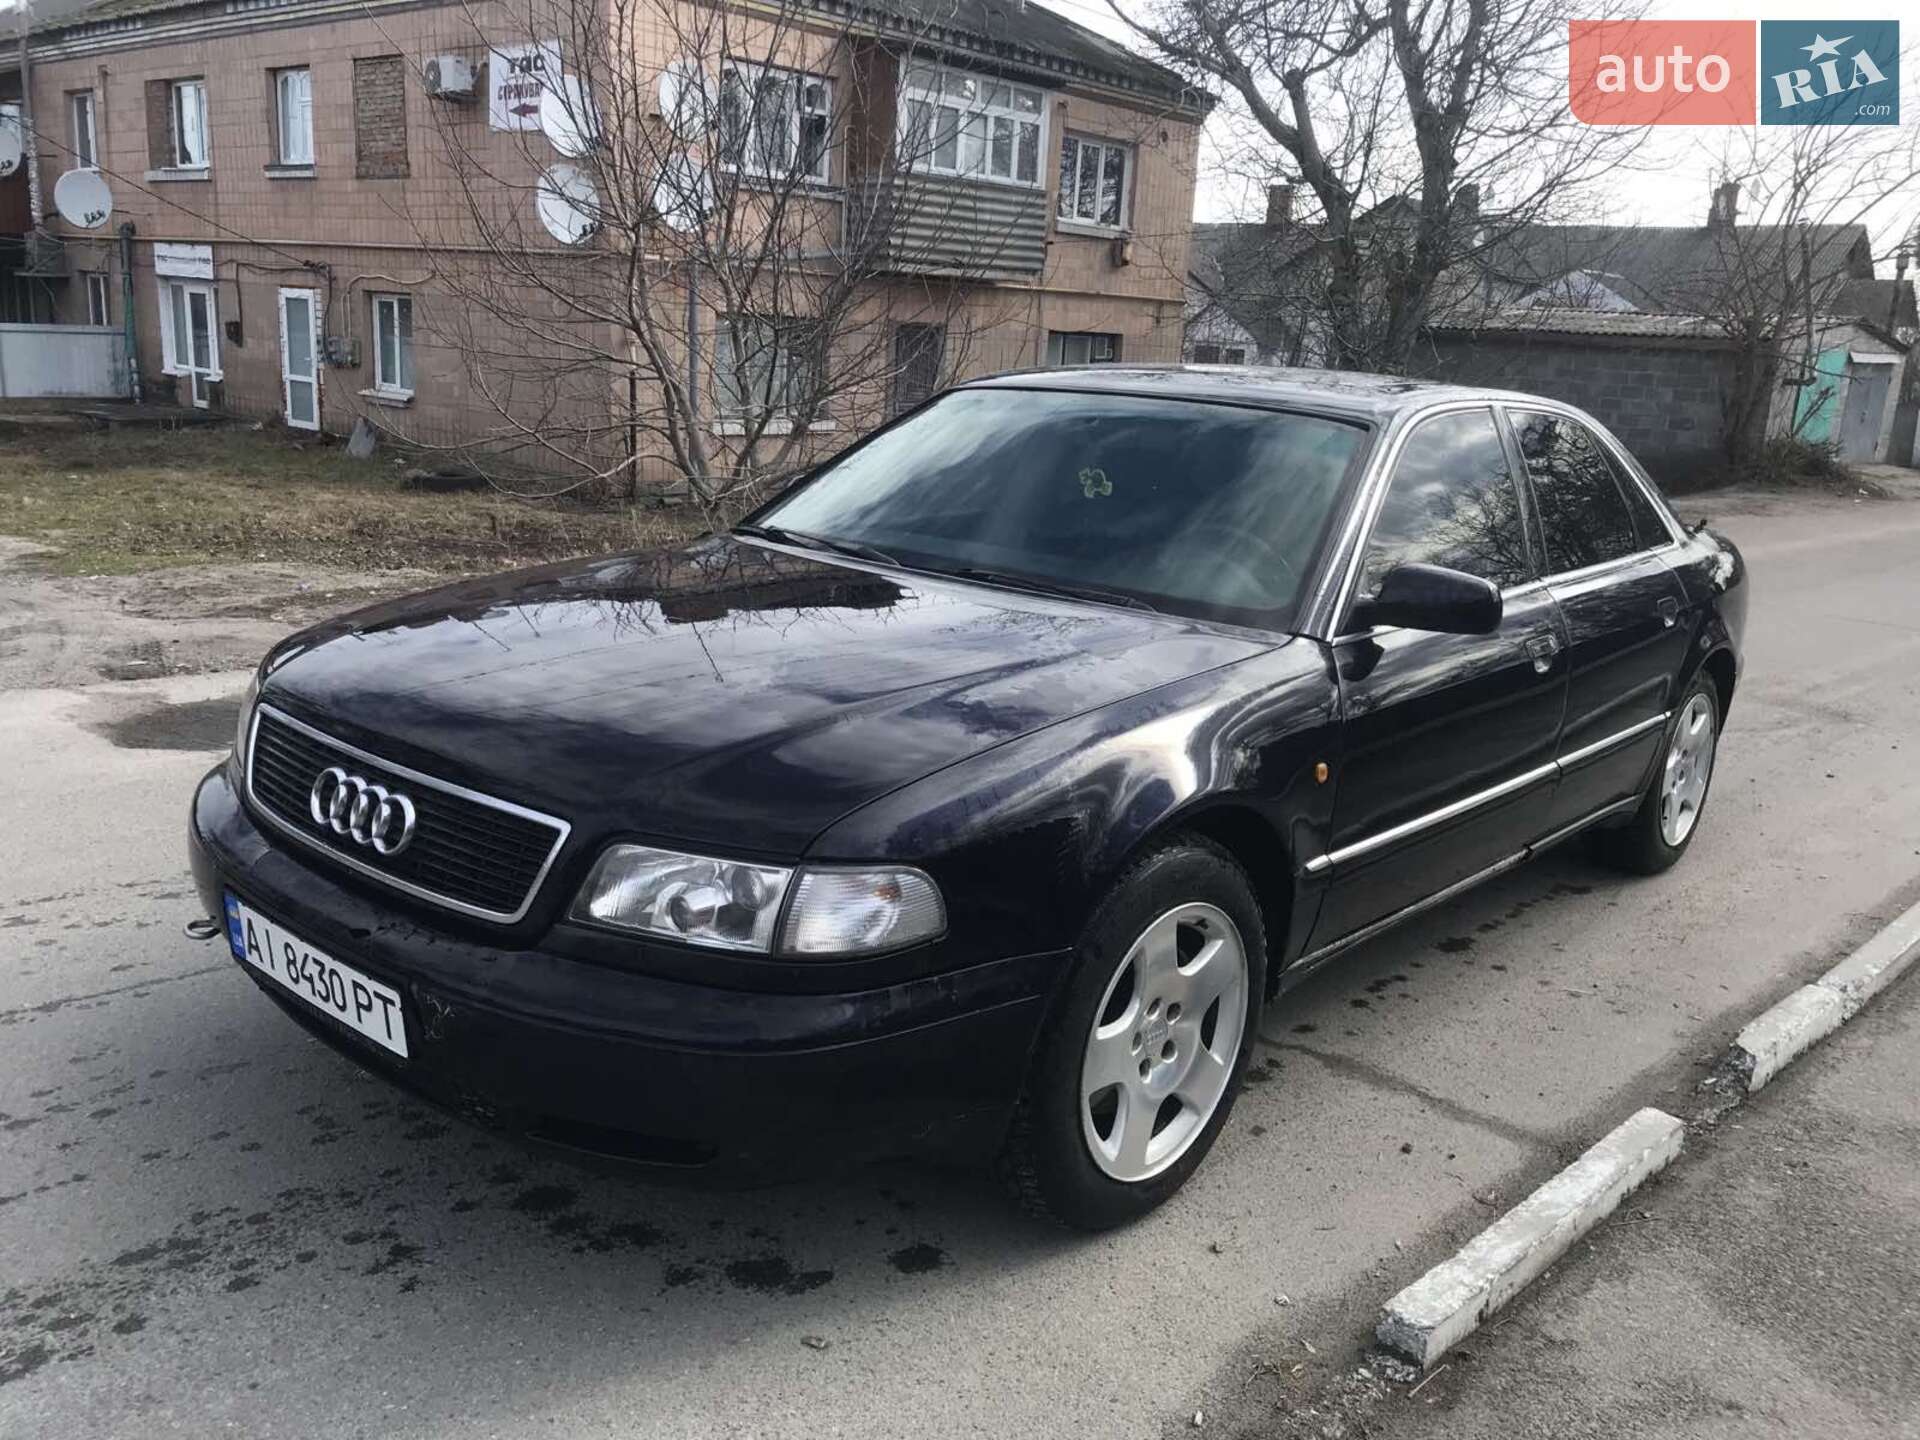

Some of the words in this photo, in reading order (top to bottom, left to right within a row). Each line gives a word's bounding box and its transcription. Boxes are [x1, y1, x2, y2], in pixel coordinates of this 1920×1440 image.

[246, 918, 276, 971] AI
[284, 941, 348, 1013] 8430
[352, 979, 396, 1041] PT
